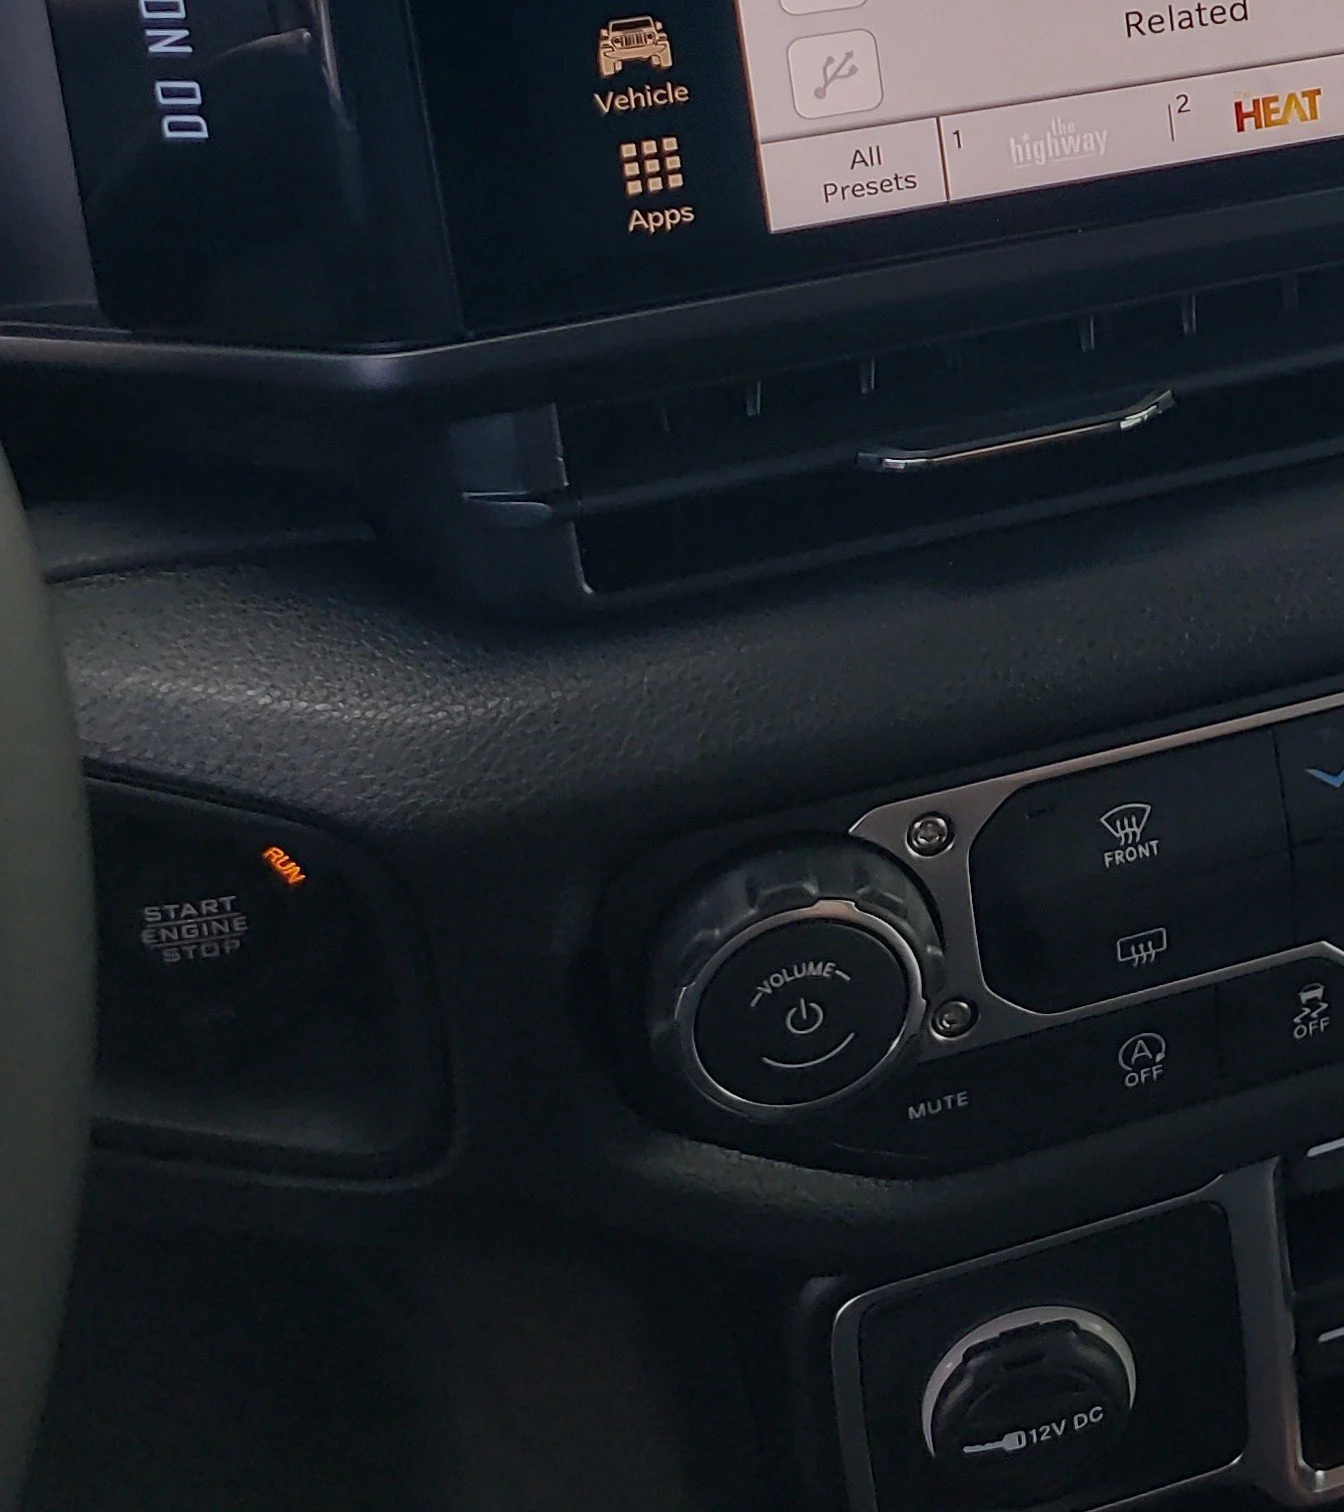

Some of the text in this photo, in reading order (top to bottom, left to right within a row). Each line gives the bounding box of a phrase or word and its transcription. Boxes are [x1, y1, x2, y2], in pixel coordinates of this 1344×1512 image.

[156, 78, 209, 143] DO
[595, 83, 689, 114] Vehicle
[1175, 94, 1190, 113] 2
[1234, 88, 1322, 132] HEAT
[953, 130, 962, 148] 1
[1052, 116, 1075, 136] the
[851, 145, 883, 169] All
[1010, 130, 1108, 165] highway
[823, 171, 917, 203] Presets
[629, 204, 694, 233] Apps
[263, 846, 307, 885] RUN
[1103, 839, 1160, 868] FRONT
[143, 895, 237, 922] START
[141, 914, 248, 944] ENGINE
[162, 939, 241, 963] STOP
[757, 961, 836, 996] VOLUME
[1292, 1015, 1332, 1040] OFF
[1124, 1064, 1165, 1088] OFF
[908, 1091, 970, 1120] MUTE
[1028, 1406, 1104, 1445] 12V DC
